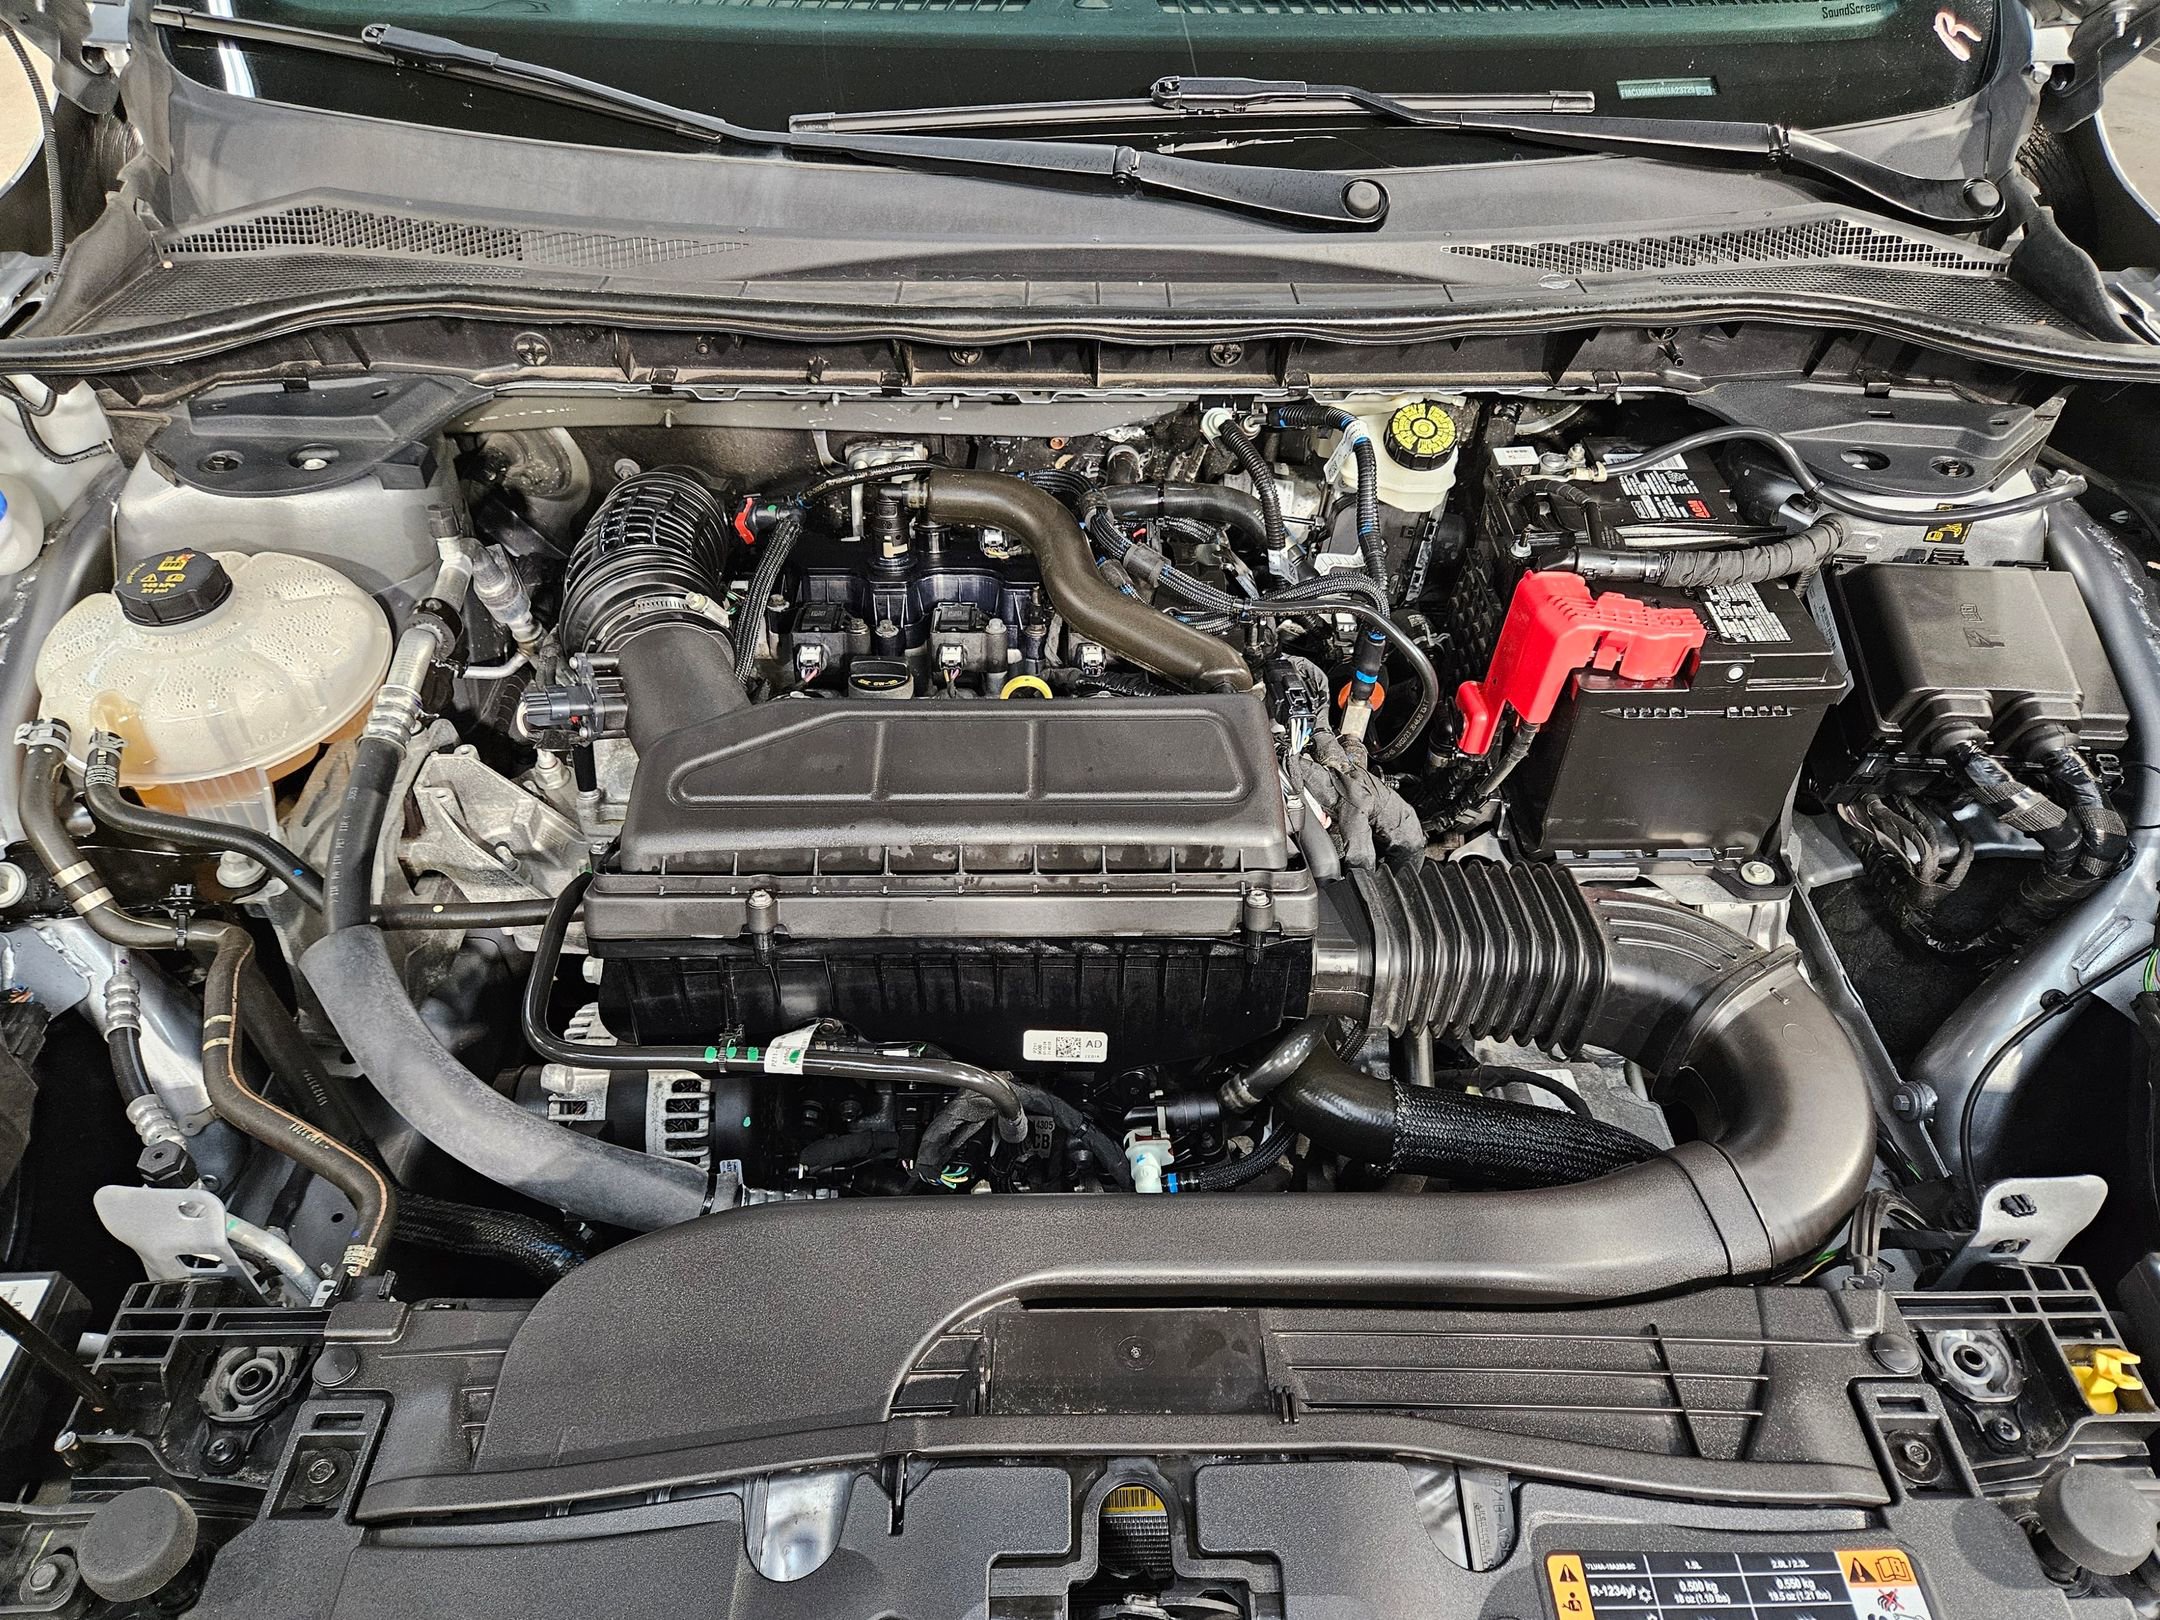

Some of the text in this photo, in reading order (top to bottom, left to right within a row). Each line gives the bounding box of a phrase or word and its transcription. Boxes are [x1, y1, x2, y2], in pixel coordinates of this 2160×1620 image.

[1822, 2, 1882, 19] SoundScreen
[1085, 1040, 1103, 1049] AD
[1590, 1584, 1637, 1600] R-1234yf
